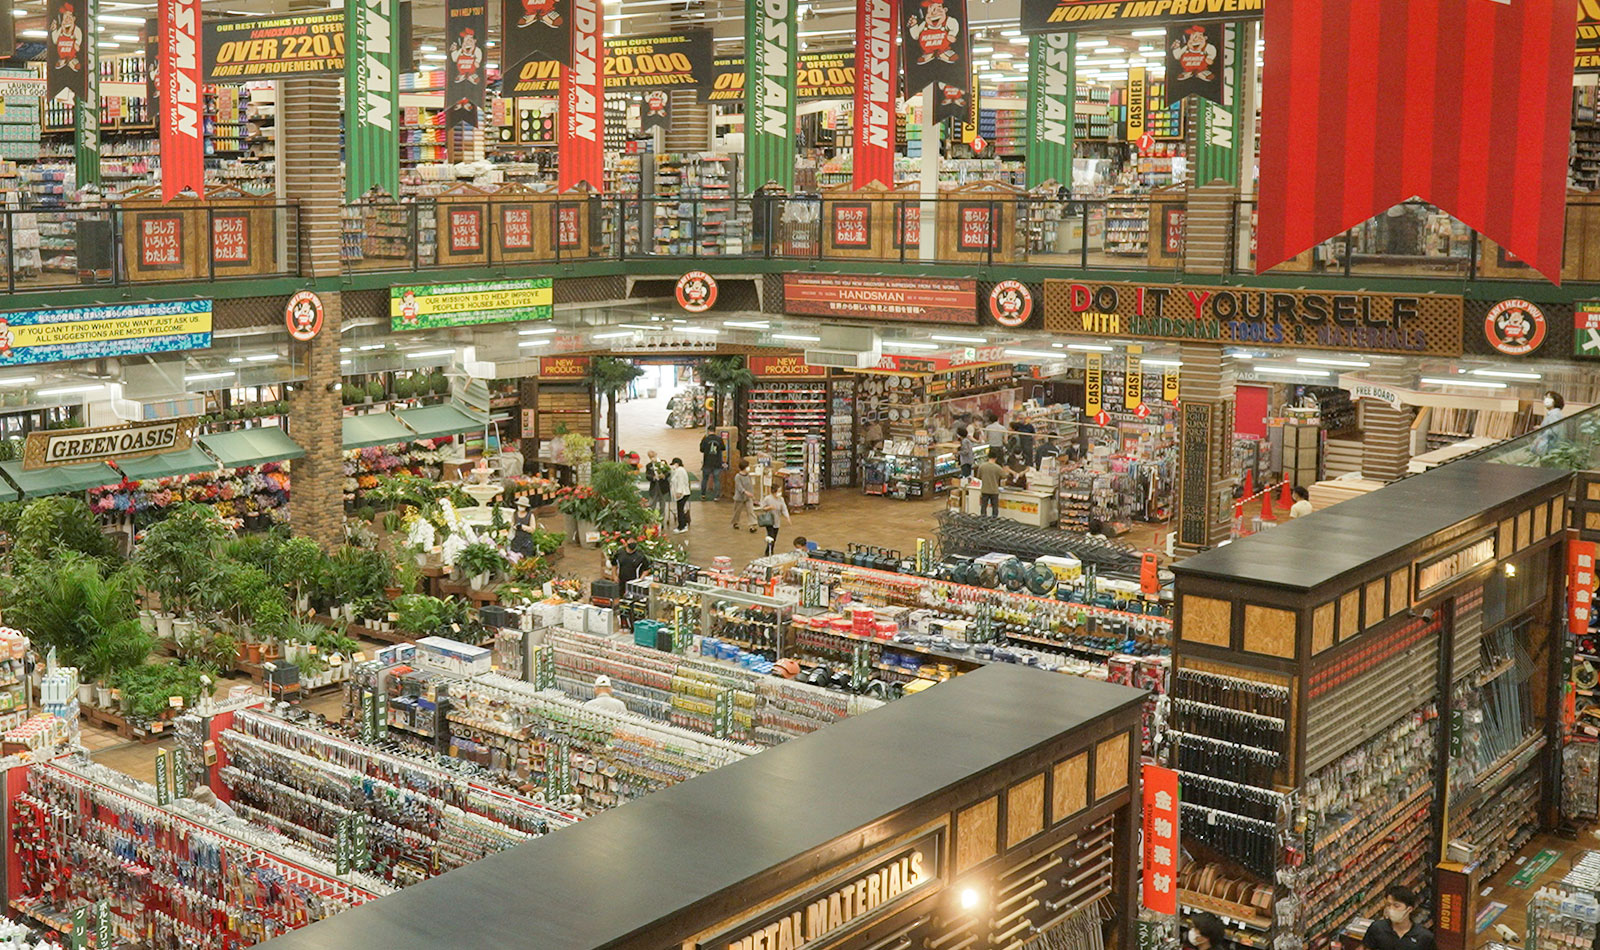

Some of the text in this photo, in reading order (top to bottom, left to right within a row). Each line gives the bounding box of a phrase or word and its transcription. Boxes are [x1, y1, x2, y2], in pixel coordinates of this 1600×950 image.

[1047, 5, 1117, 23] HOME
[216, 24, 234, 32] OUR
[235, 22, 256, 31] BEST
[257, 19, 291, 29] THANKS
[292, 17, 304, 25] TO
[305, 16, 324, 24] OUR
[251, 26, 308, 39] HANDSMAN
[216, 39, 278, 64] OVER
[614, 46, 654, 56] OFFERS
[169, 58, 176, 67] IT
[176, 0, 197, 138] SMAN
[211, 58, 345, 77] HOME IMPROVEMENT PR
[356, 7, 367, 128] LIVE IT YOUR WAY.
[806, 59, 845, 68] OFFERS
[754, 10, 763, 136] LIVE, LIVE IT YOUR WAY.
[514, 81, 546, 92] HOME
[630, 73, 699, 87] PRODUCTS.
[863, 74, 871, 91] LIVE
[568, 87, 576, 113] YOUR
[708, 91, 739, 100] HOME
[1130, 79, 1142, 128] CASHIER
[1036, 96, 1044, 120] YOUR
[170, 108, 178, 136] WAY.
[568, 116, 576, 139] WAY.
[1036, 122, 1044, 143] WAY.
[1141, 135, 1149, 148] 7
[974, 138, 982, 149] 5
[441, 295, 470, 303] MISSION
[491, 292, 509, 300] HELP
[511, 290, 539, 299] IMPROVE
[839, 289, 905, 302] HANDSMAN
[432, 303, 465, 312] PEOPLE'S
[467, 301, 494, 309] HOUSES
[1071, 284, 1419, 329] DO IT YOURSELF
[44, 325, 69, 334] CAN'T
[71, 324, 90, 332] FIND
[91, 322, 113, 330] WHAT
[132, 319, 153, 327] WANT
[53, 330, 108, 341] SUGGESTIONS
[126, 327, 148, 335] MOST
[1081, 312, 1426, 351] WITH HANDSMAN TOOLS & MATERIALS
[544, 366, 584, 374] PRODUCTS
[555, 359, 574, 367] NEW
[765, 365, 809, 374] PRODUCTS
[777, 358, 797, 366] NEW
[1088, 358, 1100, 405] CASHIER
[1356, 386, 1396, 403] FREE BOARD
[1098, 412, 1105, 425] 1
[1139, 405, 1146, 417] 2
[52, 427, 175, 460] GREEN OASIS
[1451, 710, 1461, 759] アンカー
[728, 851, 924, 950] ETAL MATERIALS
[1441, 893, 1451, 930] WAGON
[99, 901, 109, 950] ボルトクリッ
[1138, 922, 1149, 950] ステン
